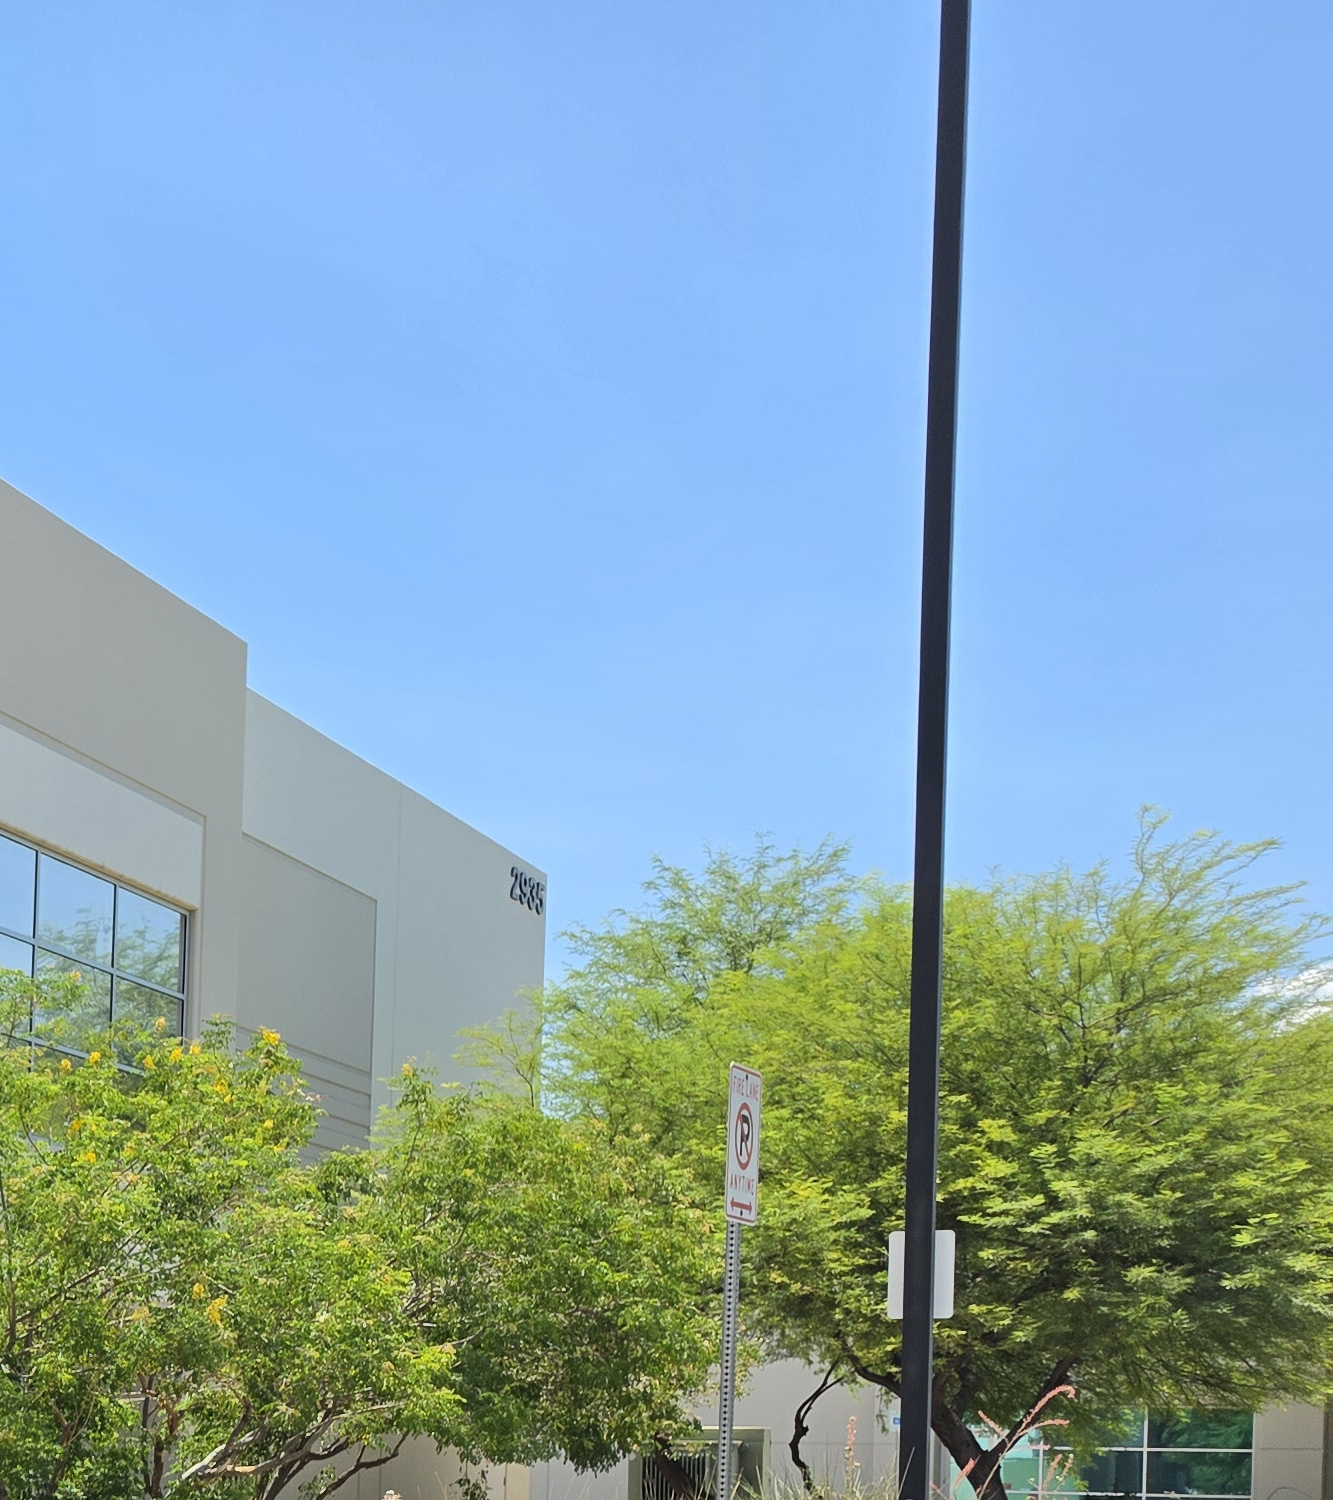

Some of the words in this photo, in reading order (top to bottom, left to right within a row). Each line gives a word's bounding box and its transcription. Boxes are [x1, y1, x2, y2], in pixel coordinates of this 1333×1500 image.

[509, 866, 545, 915] 2935
[734, 1075, 745, 1097] FIRE
[746, 1077, 759, 1101] LANE
[730, 1173, 755, 1196] ANYTIME
